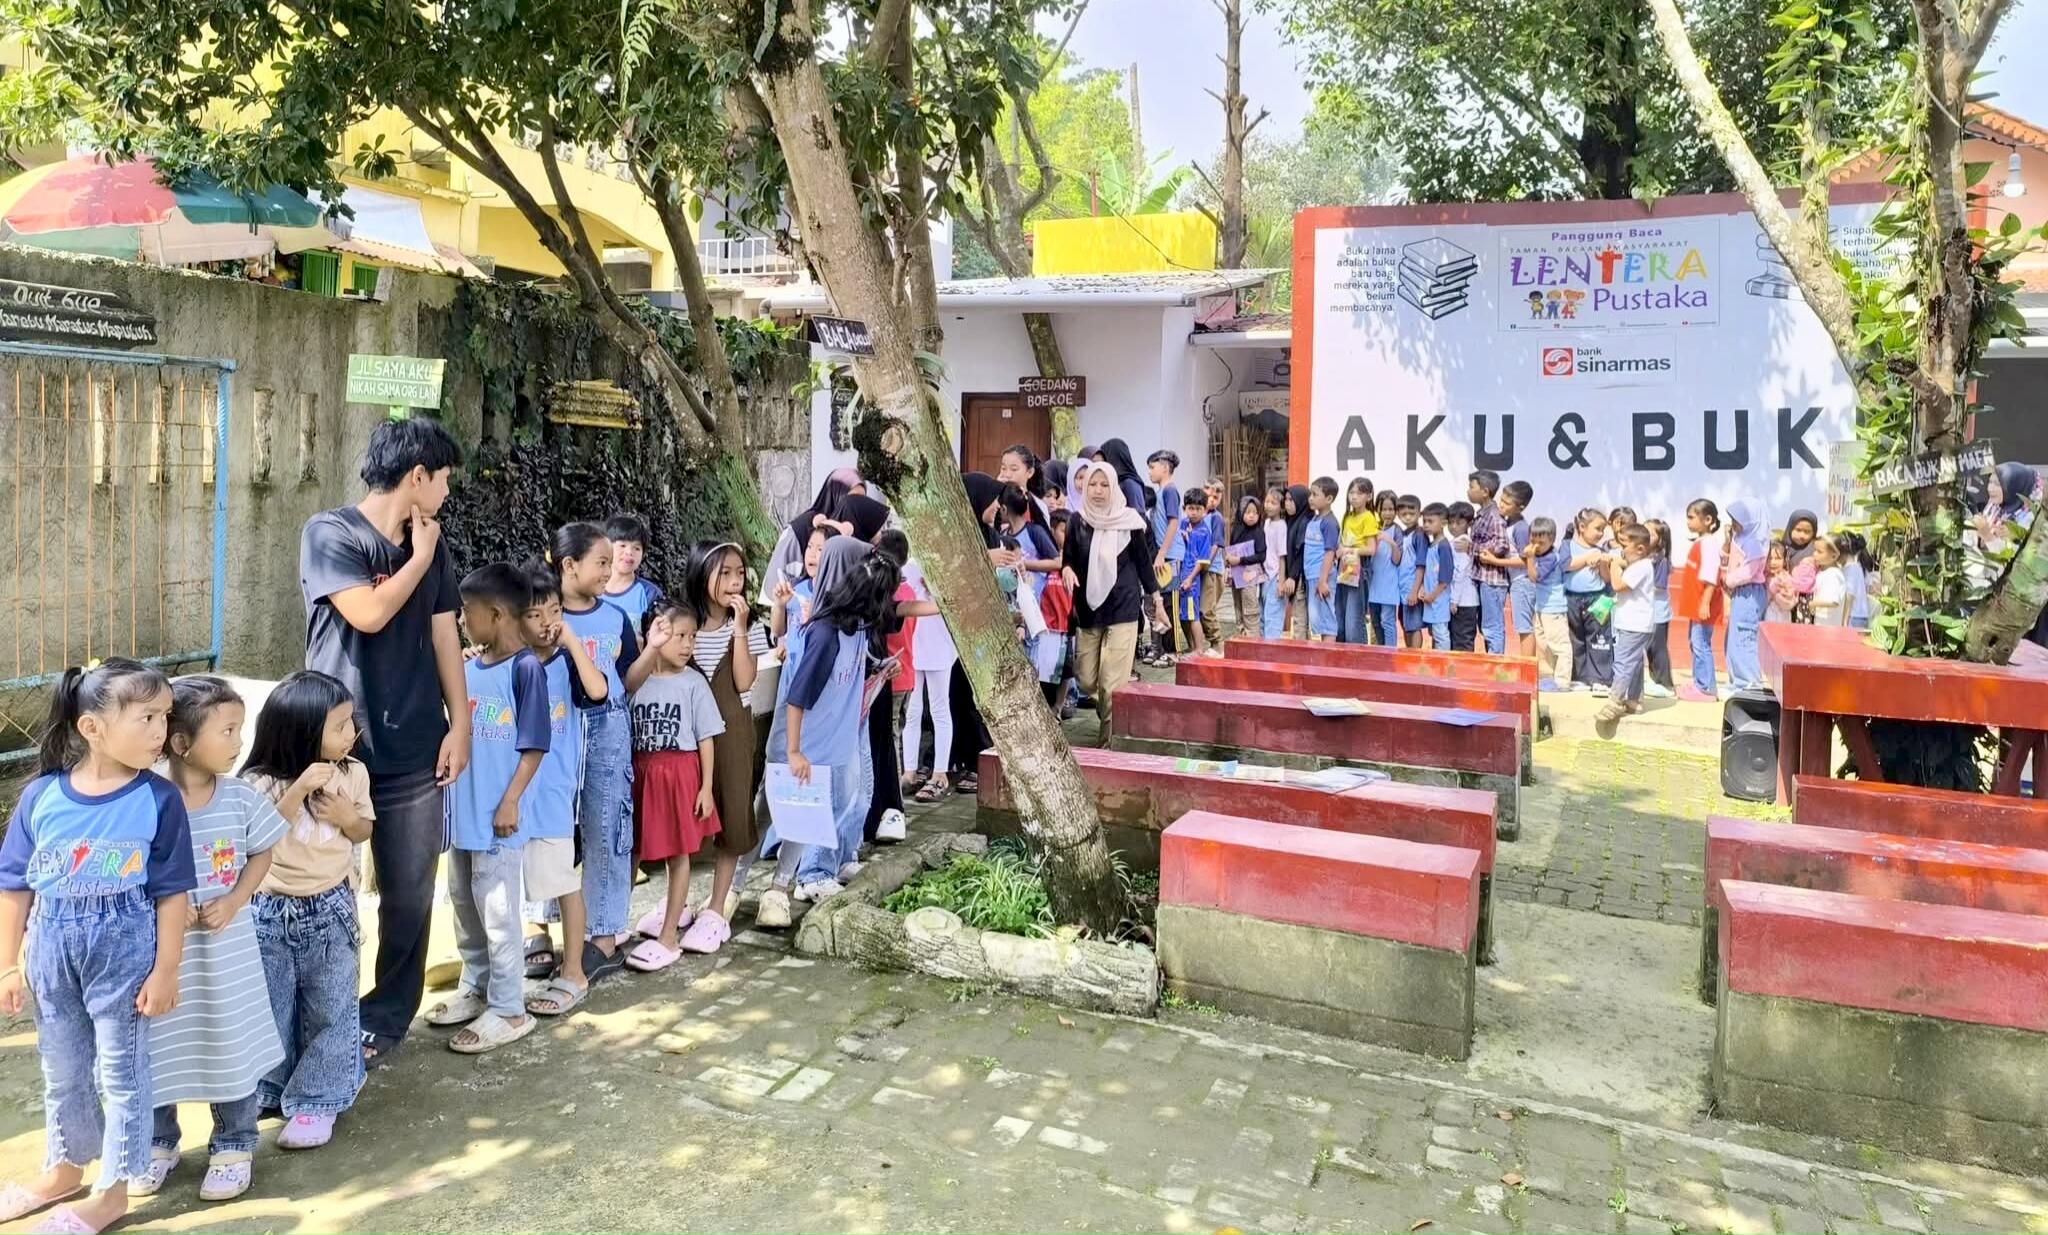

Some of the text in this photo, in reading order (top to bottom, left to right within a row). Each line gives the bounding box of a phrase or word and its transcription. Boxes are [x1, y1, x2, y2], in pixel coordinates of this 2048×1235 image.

[1551, 228, 1662, 242] Panggung Baca
[1346, 246, 1369, 256] Buku
[1613, 240, 1689, 251] MASYARAKAT
[1336, 257, 1396, 267] adalah buku
[1510, 247, 1708, 287] LENTERA
[1351, 268, 1396, 280] baru bagi
[1333, 280, 1396, 292] mereka yang
[1366, 291, 1395, 301] belum
[1593, 284, 1708, 312] Pustaka
[819, 322, 857, 351] BACA
[1576, 347, 1602, 357] bank
[374, 361, 406, 378] SAMA
[408, 363, 433, 380] AKU
[1576, 357, 1672, 373] sinarmas
[349, 379, 376, 396] NIKAH
[377, 381, 401, 398] SAMA
[1024, 378, 1077, 393] GOEDANG
[1027, 393, 1074, 408] BOEKOE
[1336, 413, 1514, 471] AKU
[1547, 412, 1592, 469] &
[1874, 463, 1914, 489] BACA
[634, 702, 682, 721] OGJA
[634, 720, 681, 738] NITED
